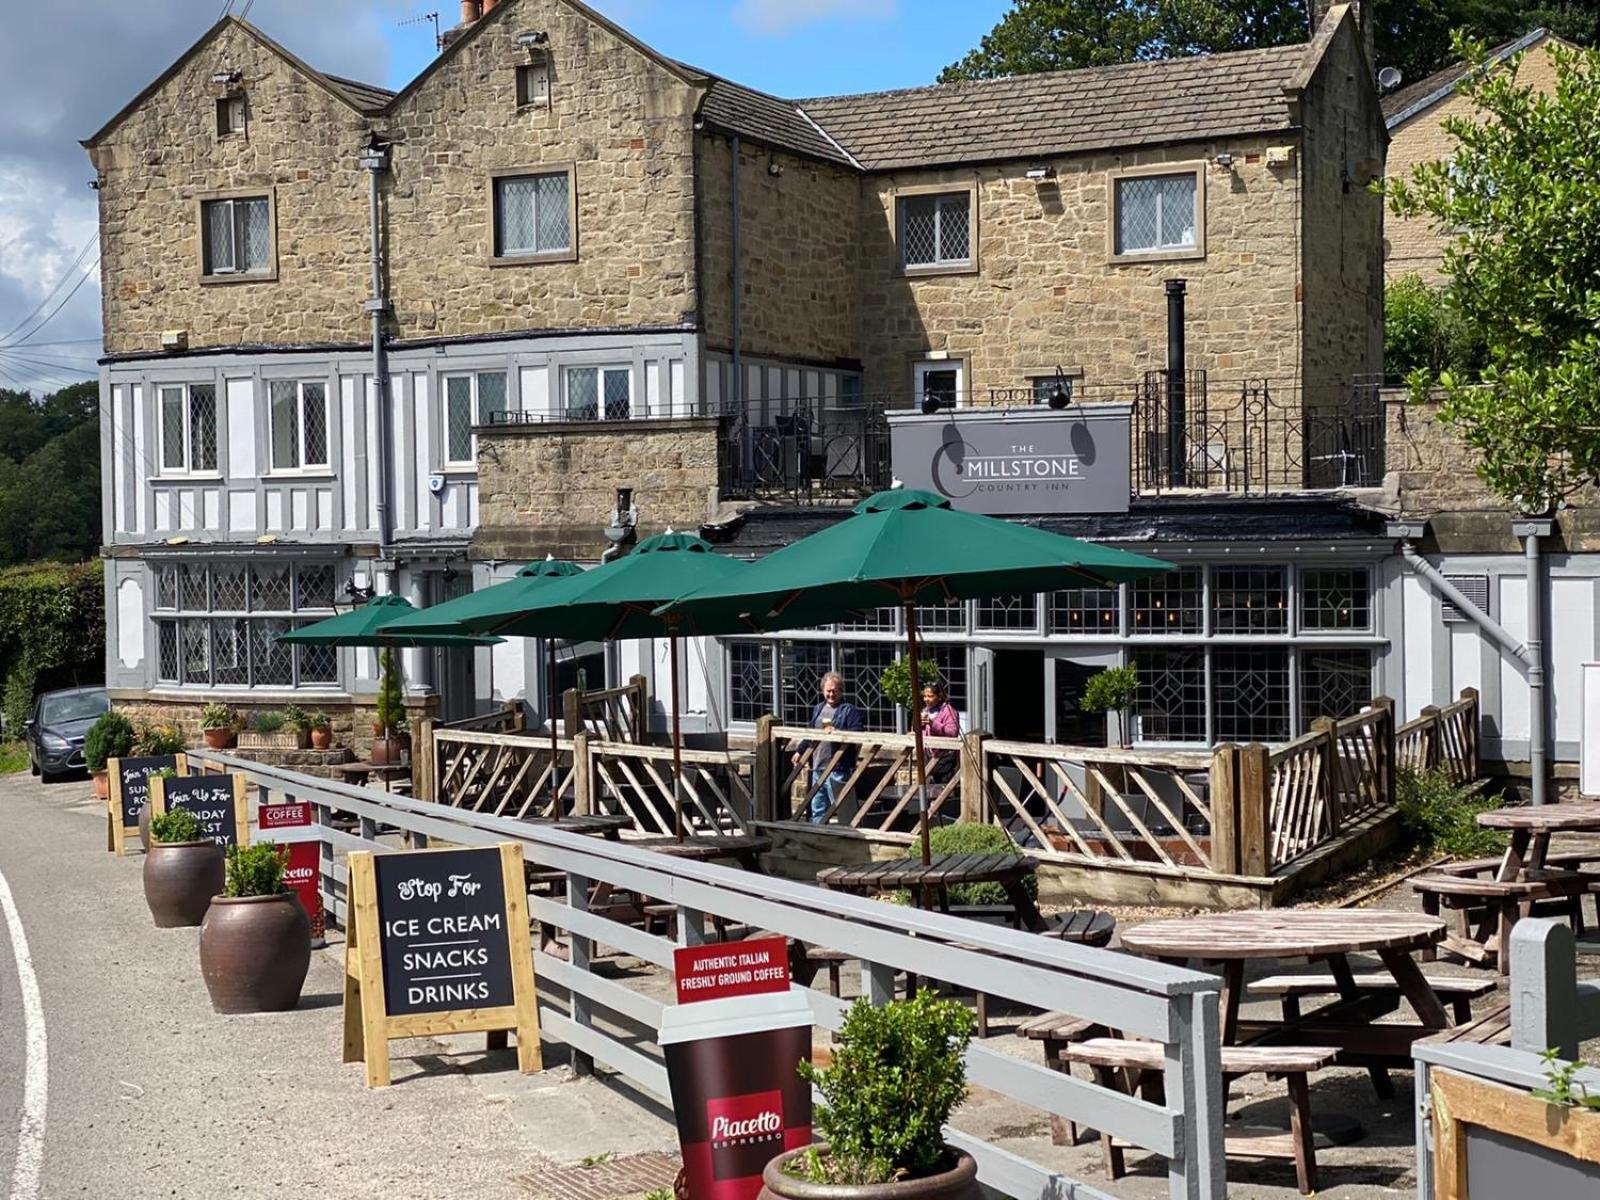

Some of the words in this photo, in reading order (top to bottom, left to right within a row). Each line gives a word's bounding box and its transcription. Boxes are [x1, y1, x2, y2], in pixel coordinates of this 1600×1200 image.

[1011, 445, 1034, 453] THE
[968, 459, 1079, 477] MILLSTONE
[978, 483, 1037, 492] COUNTRY
[1046, 483, 1069, 491] INN
[123, 769, 141, 783] Join
[168, 791, 190, 808] Join
[211, 788, 231, 801] For
[266, 810, 304, 820] COFFEE
[398, 877, 442, 902] Stop
[448, 873, 481, 897] For
[386, 919, 420, 938] ICE
[427, 913, 501, 935] CREAM
[403, 948, 489, 971] SNACKS
[692, 955, 737, 972] AUTHENTIC
[739, 951, 770, 966] ITALIAN
[680, 974, 717, 991] FRESHLY
[718, 970, 752, 986] GROUND
[753, 966, 785, 982] COFFEE
[408, 982, 490, 1005] DRINKS
[712, 1111, 781, 1140] Piacetto
[713, 1132, 782, 1149] ESPRESSO
